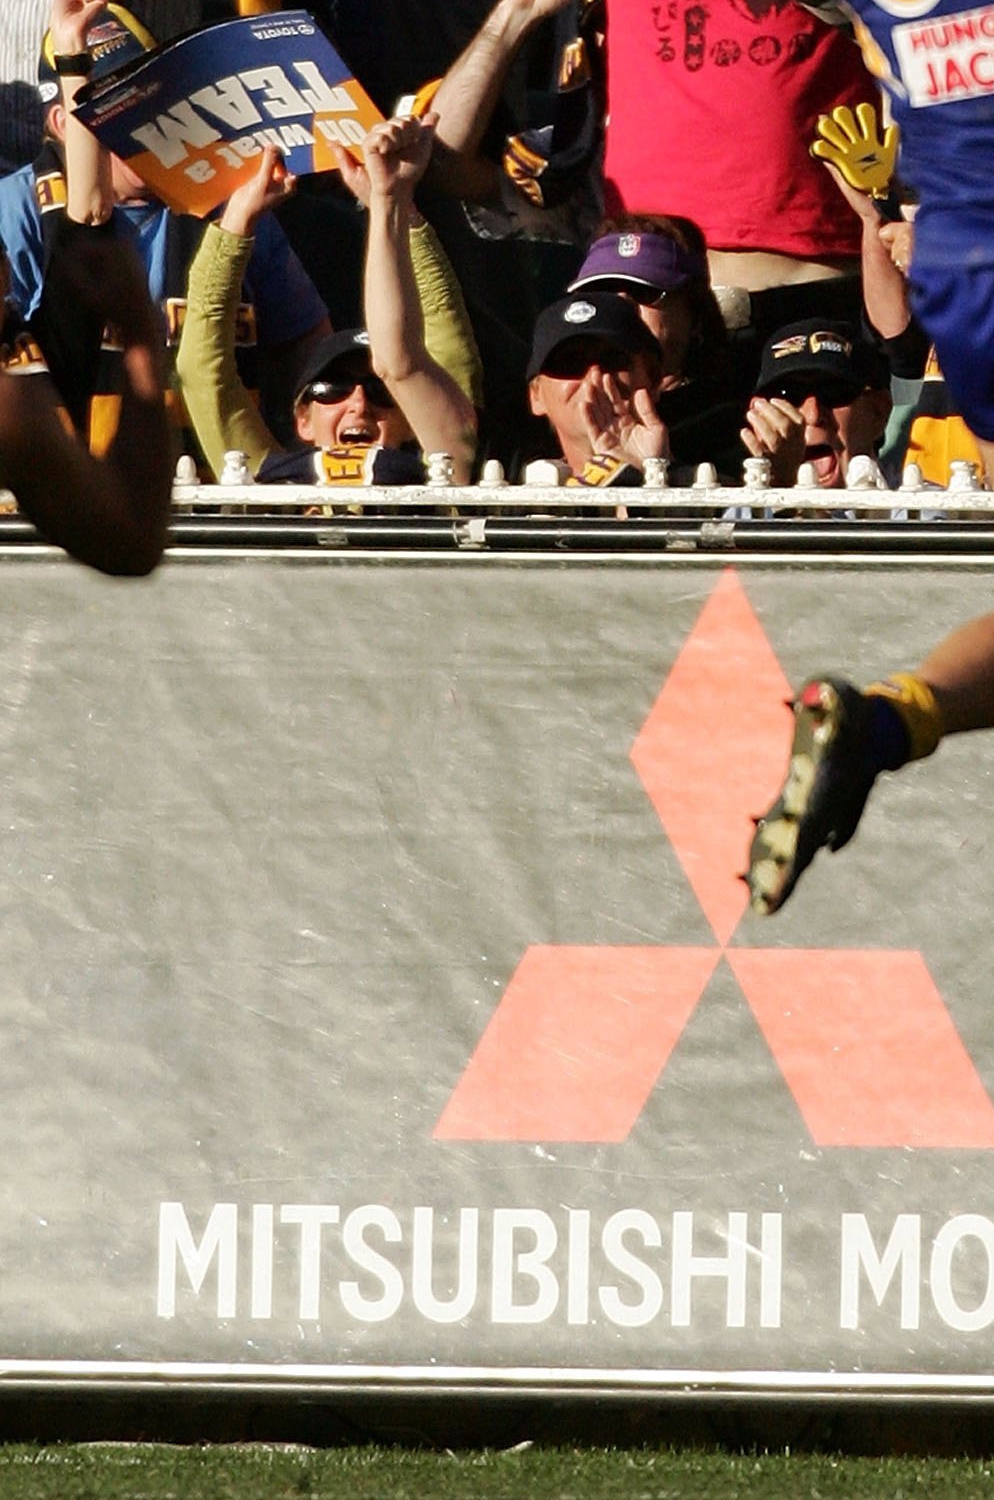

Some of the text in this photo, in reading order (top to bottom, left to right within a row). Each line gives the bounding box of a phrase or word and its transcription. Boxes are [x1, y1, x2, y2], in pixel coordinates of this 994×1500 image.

[253, 26, 298, 41] TOYOTA
[131, 61, 358, 170] TEAM
[216, 122, 315, 169] what
[184, 158, 216, 184] a
[156, 1201, 782, 1328] MITSUBISHI
